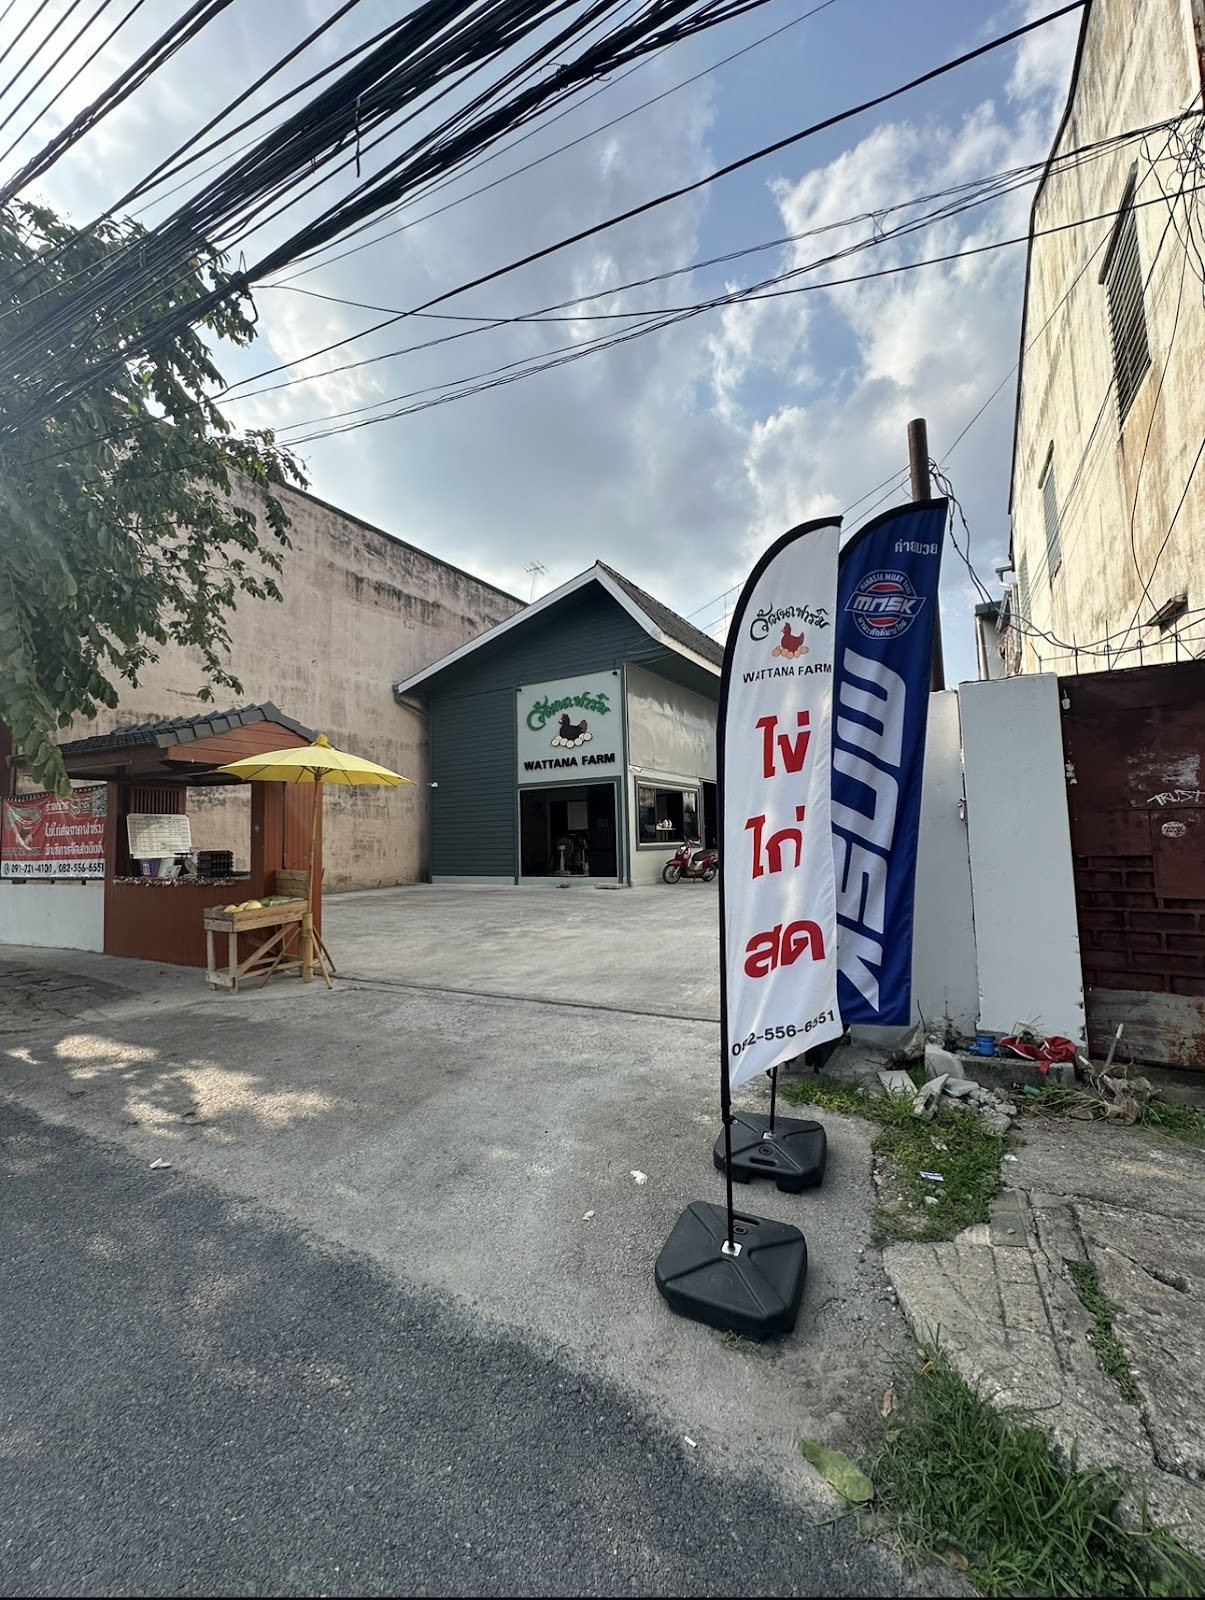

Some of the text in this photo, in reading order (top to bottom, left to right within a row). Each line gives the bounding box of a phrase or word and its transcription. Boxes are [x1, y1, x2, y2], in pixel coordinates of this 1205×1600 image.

[895, 539, 938, 555] ค่ายมวย
[885, 573, 905, 583] MUAY
[743, 663, 832, 684] WATTANA FARM
[755, 710, 811, 779] ไข่
[524, 753, 615, 771] WATTANA FARM
[744, 805, 806, 880] ไก่
[744, 919, 826, 978] สด
